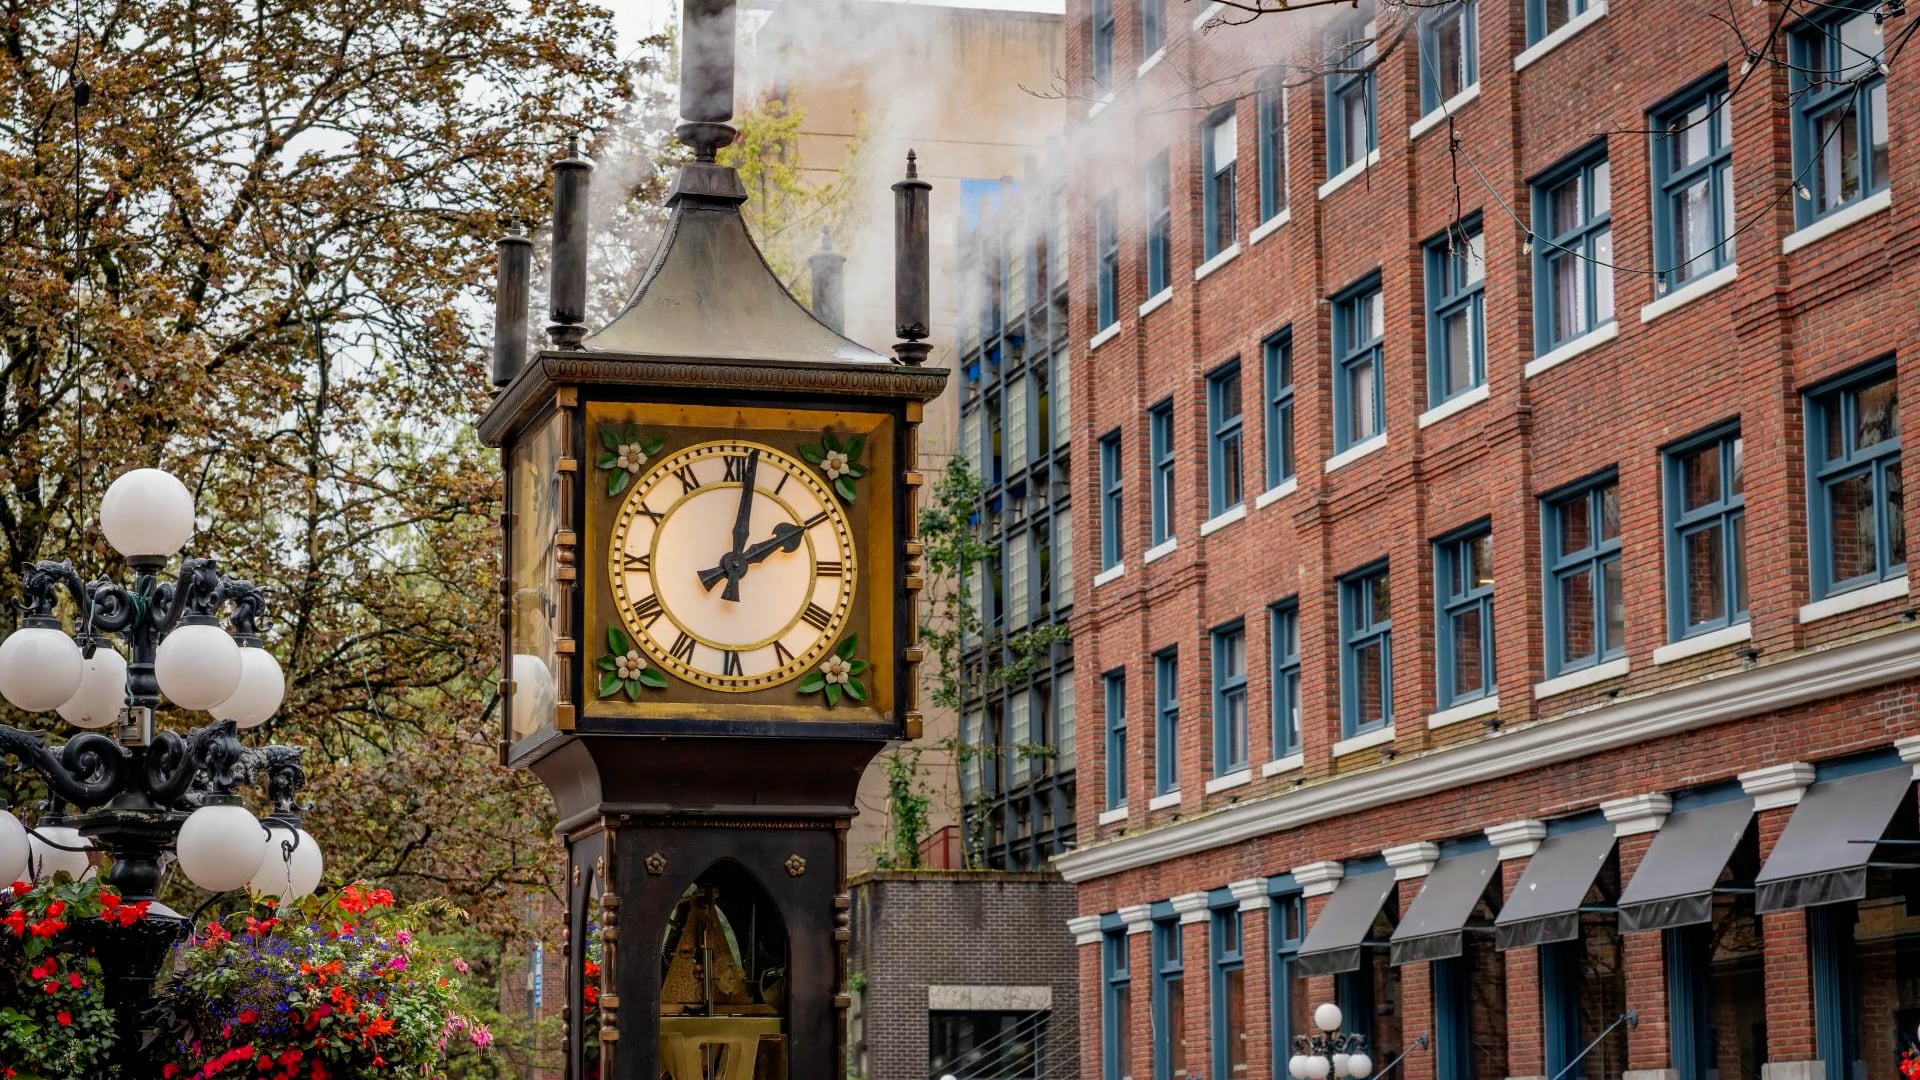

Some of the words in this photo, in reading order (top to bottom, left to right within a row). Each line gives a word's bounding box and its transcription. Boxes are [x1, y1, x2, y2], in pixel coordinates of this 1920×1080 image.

[672, 464, 701, 495] XI
[722, 455, 747, 482] XII
[774, 471, 791, 495] I
[635, 501, 665, 528] X
[803, 510, 831, 530] II
[624, 552, 651, 572] IX
[816, 561, 842, 577] III
[632, 593, 664, 630] VIII
[801, 601, 833, 633] IIII
[669, 631, 697, 665] VII
[773, 639, 795, 667] V
[723, 650, 744, 677] VI
